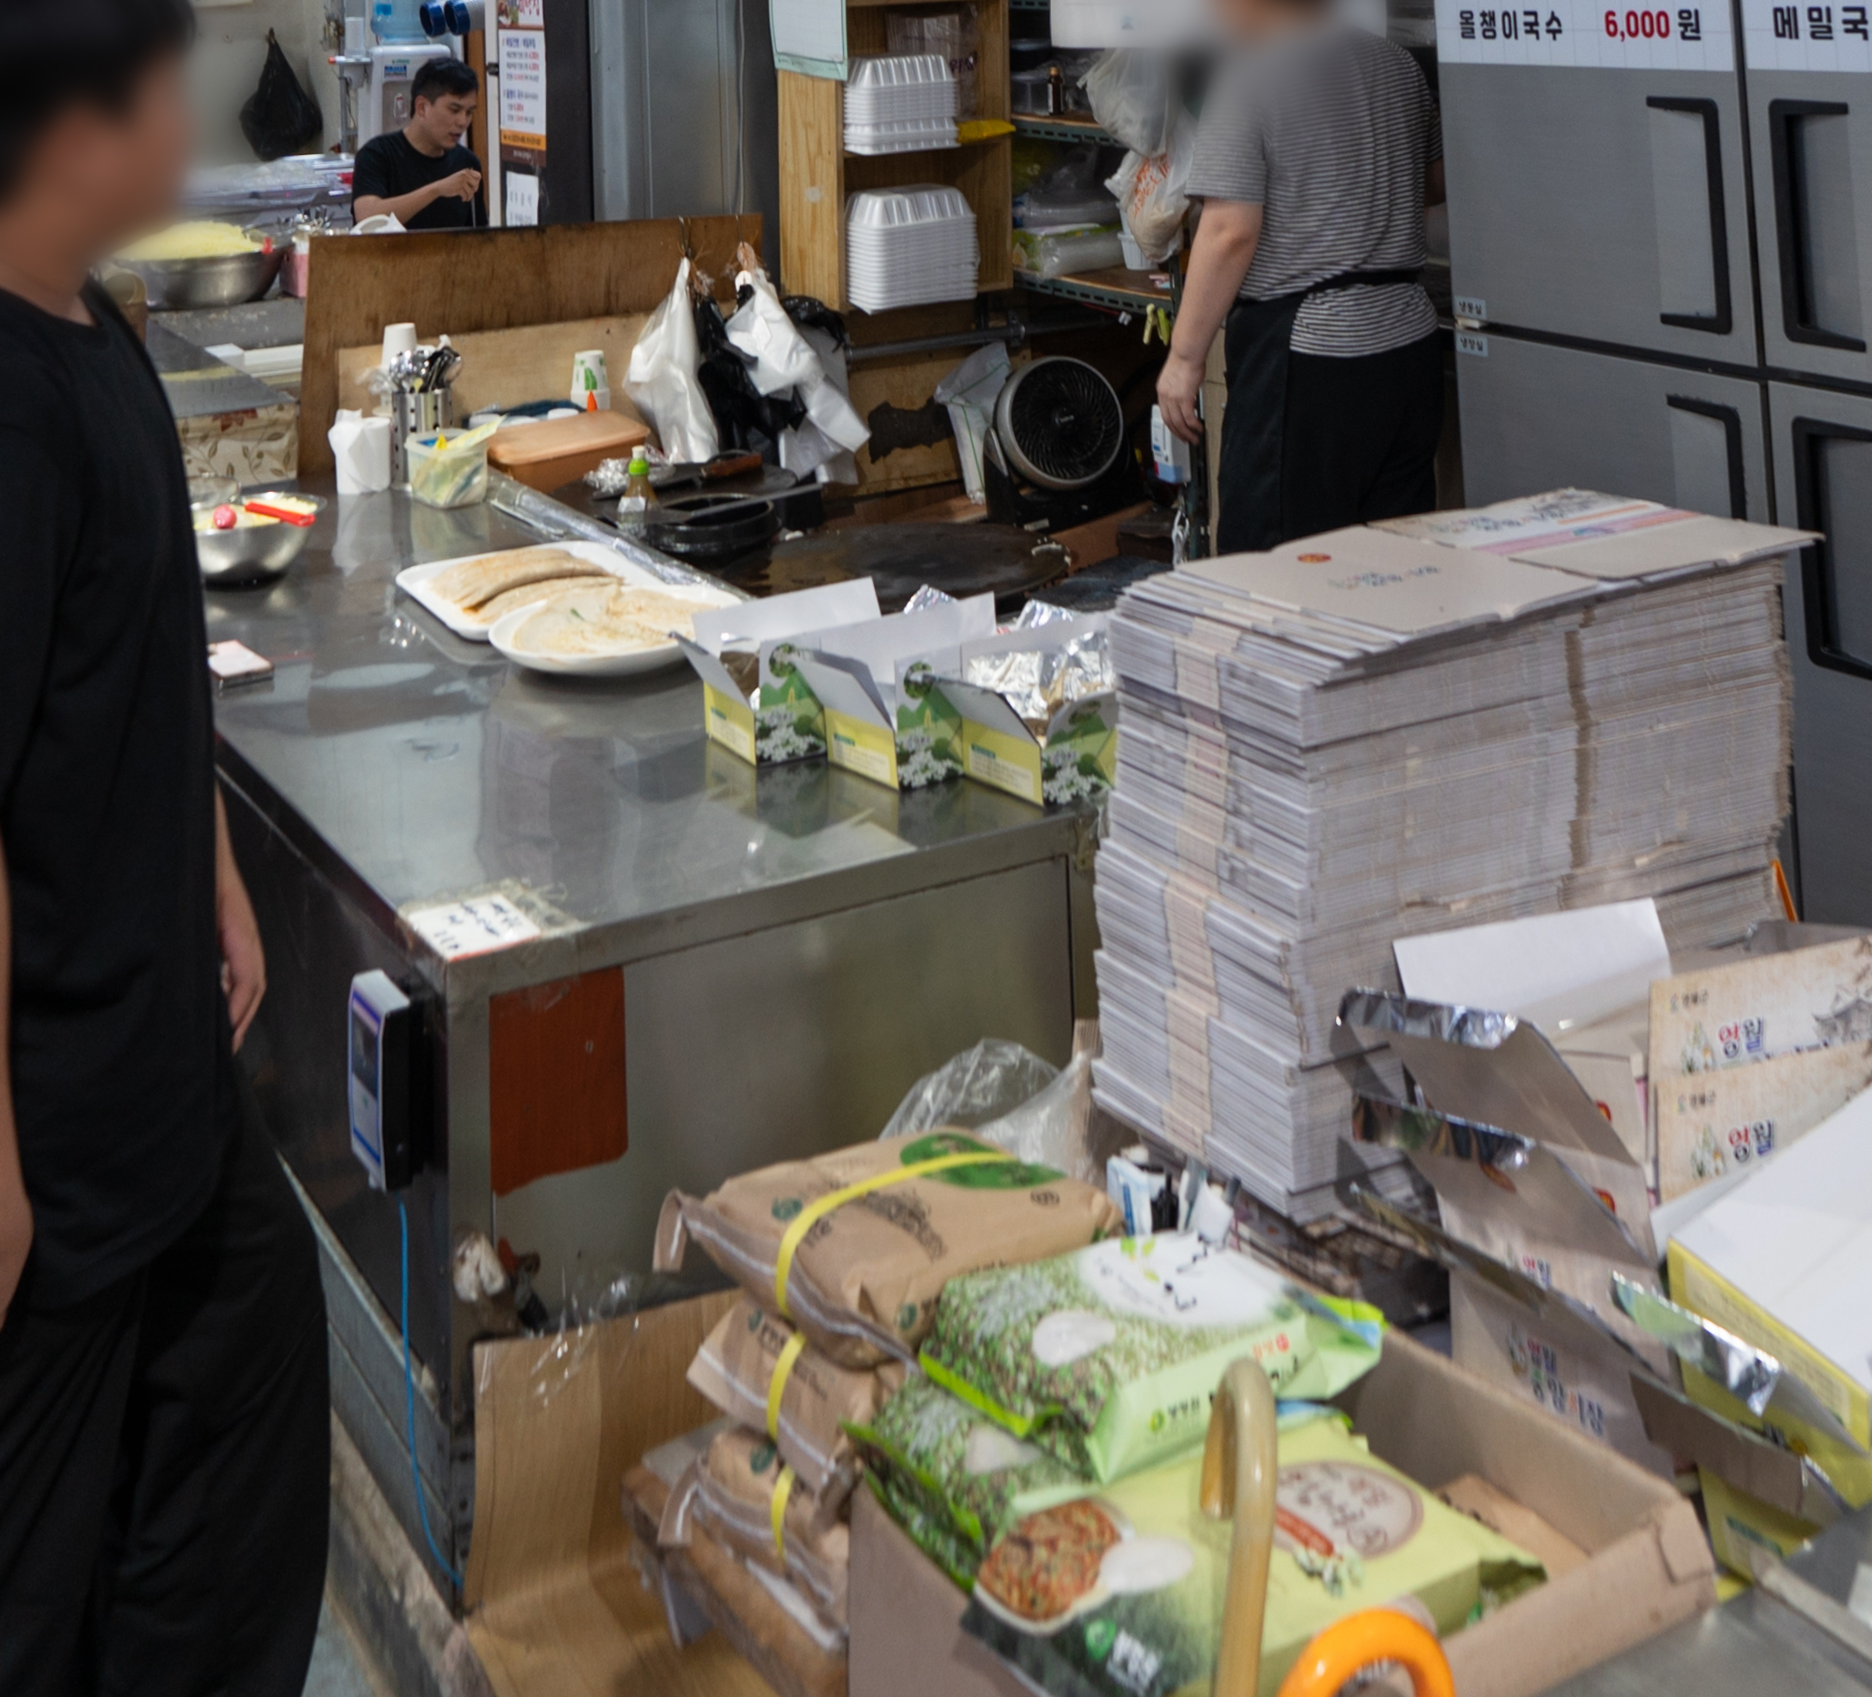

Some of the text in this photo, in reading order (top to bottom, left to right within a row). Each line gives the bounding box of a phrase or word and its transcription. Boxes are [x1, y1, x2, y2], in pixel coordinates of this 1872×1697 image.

[1458, 8, 1702, 43] 올챙이국수 6,000 원
[1717, 1015, 1765, 1060] 영월
[1728, 1118, 1775, 1164] 영월
